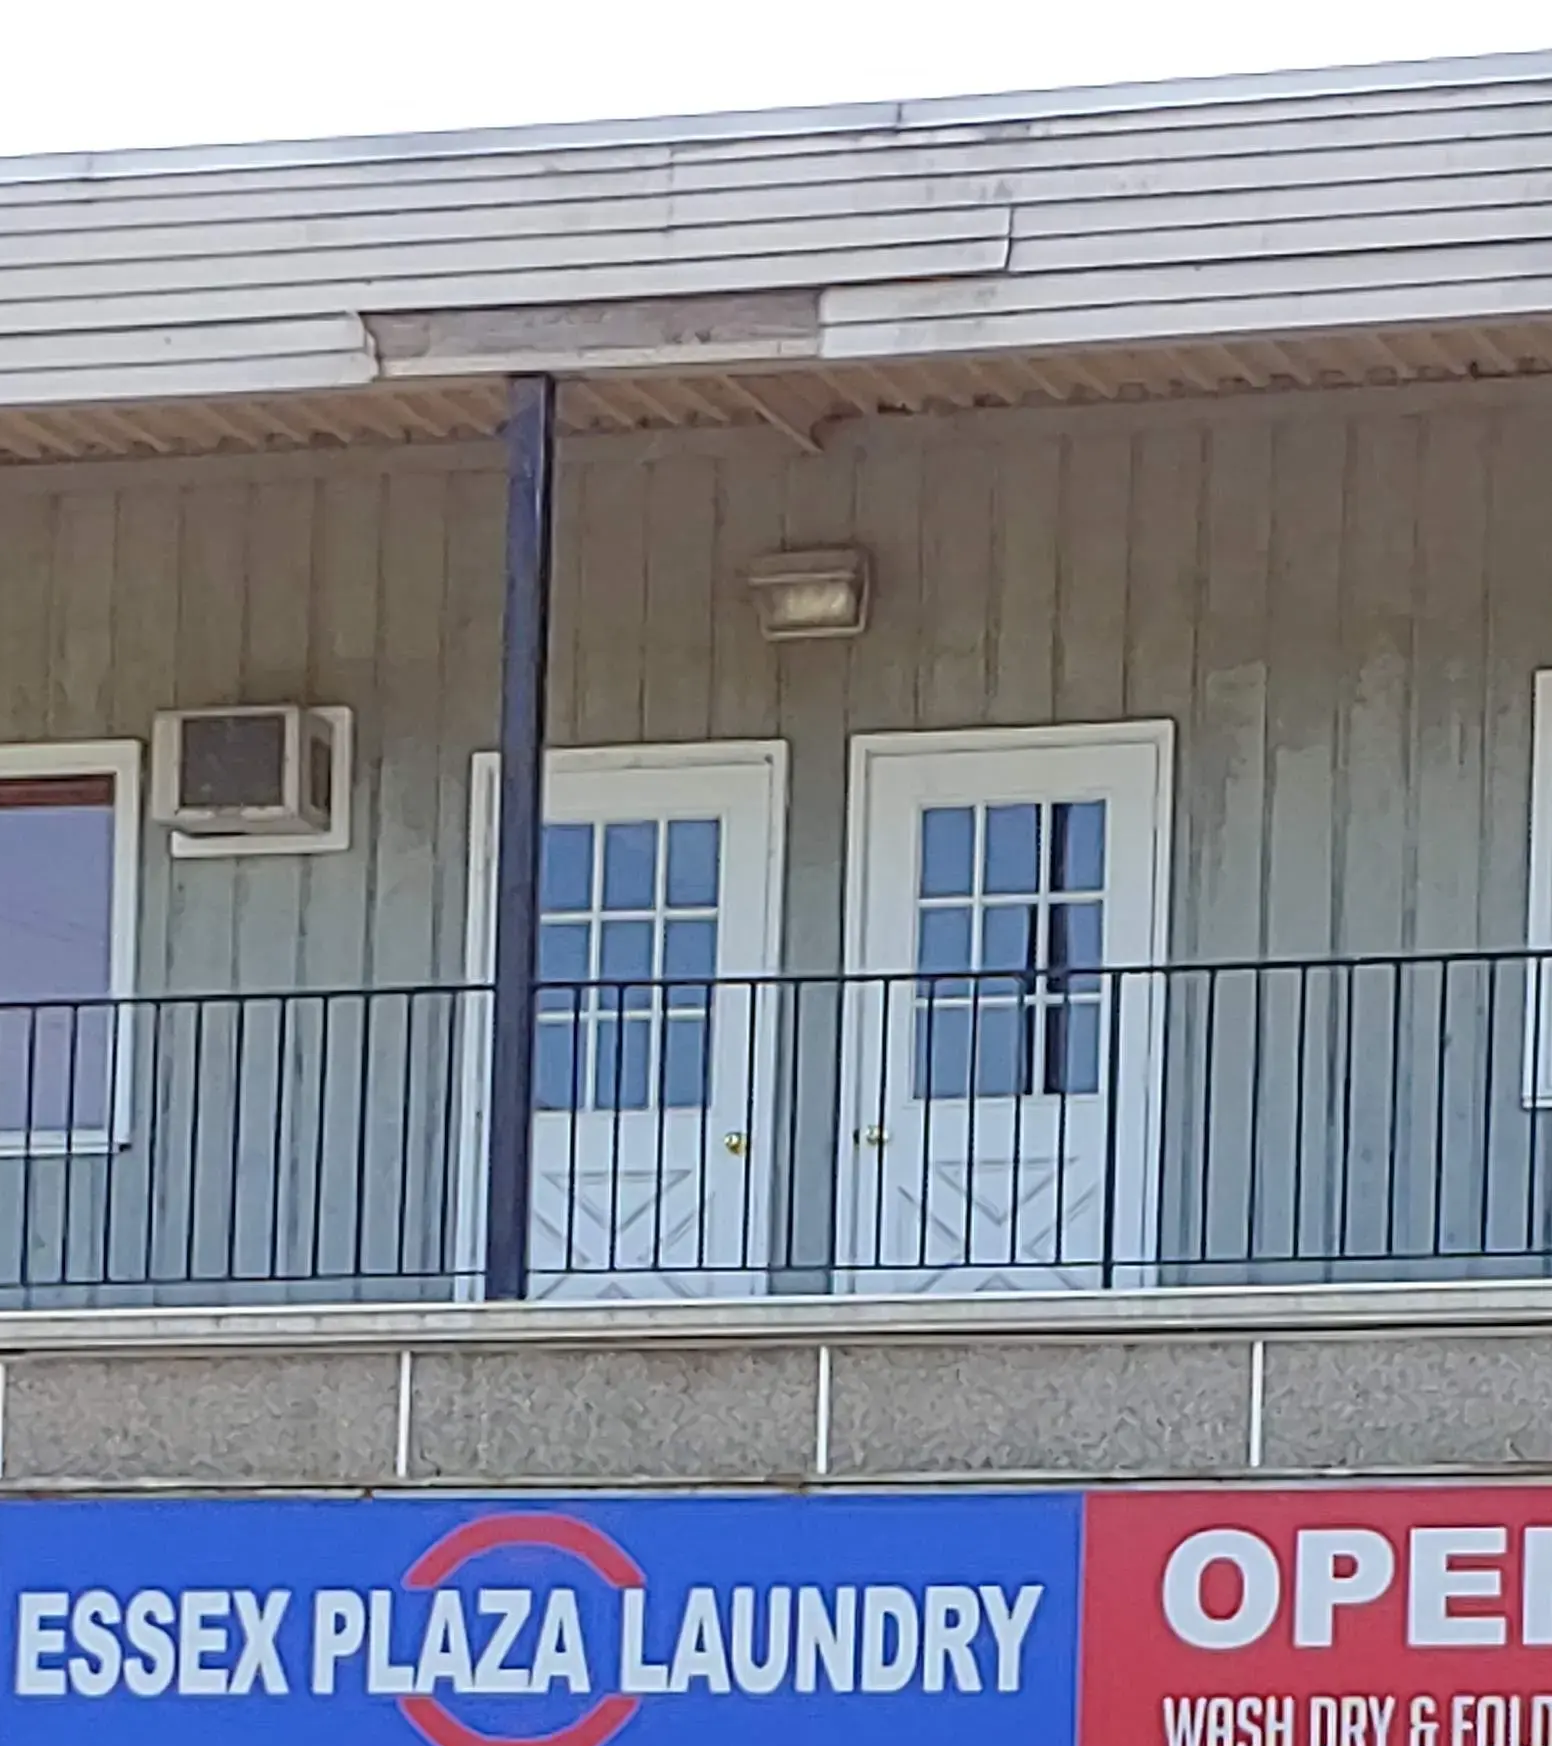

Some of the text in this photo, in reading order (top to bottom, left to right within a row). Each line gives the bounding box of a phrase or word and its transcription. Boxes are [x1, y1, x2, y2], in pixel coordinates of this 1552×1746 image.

[14, 1583, 1044, 1697] ESSEX PLAZA LAUNDRY
